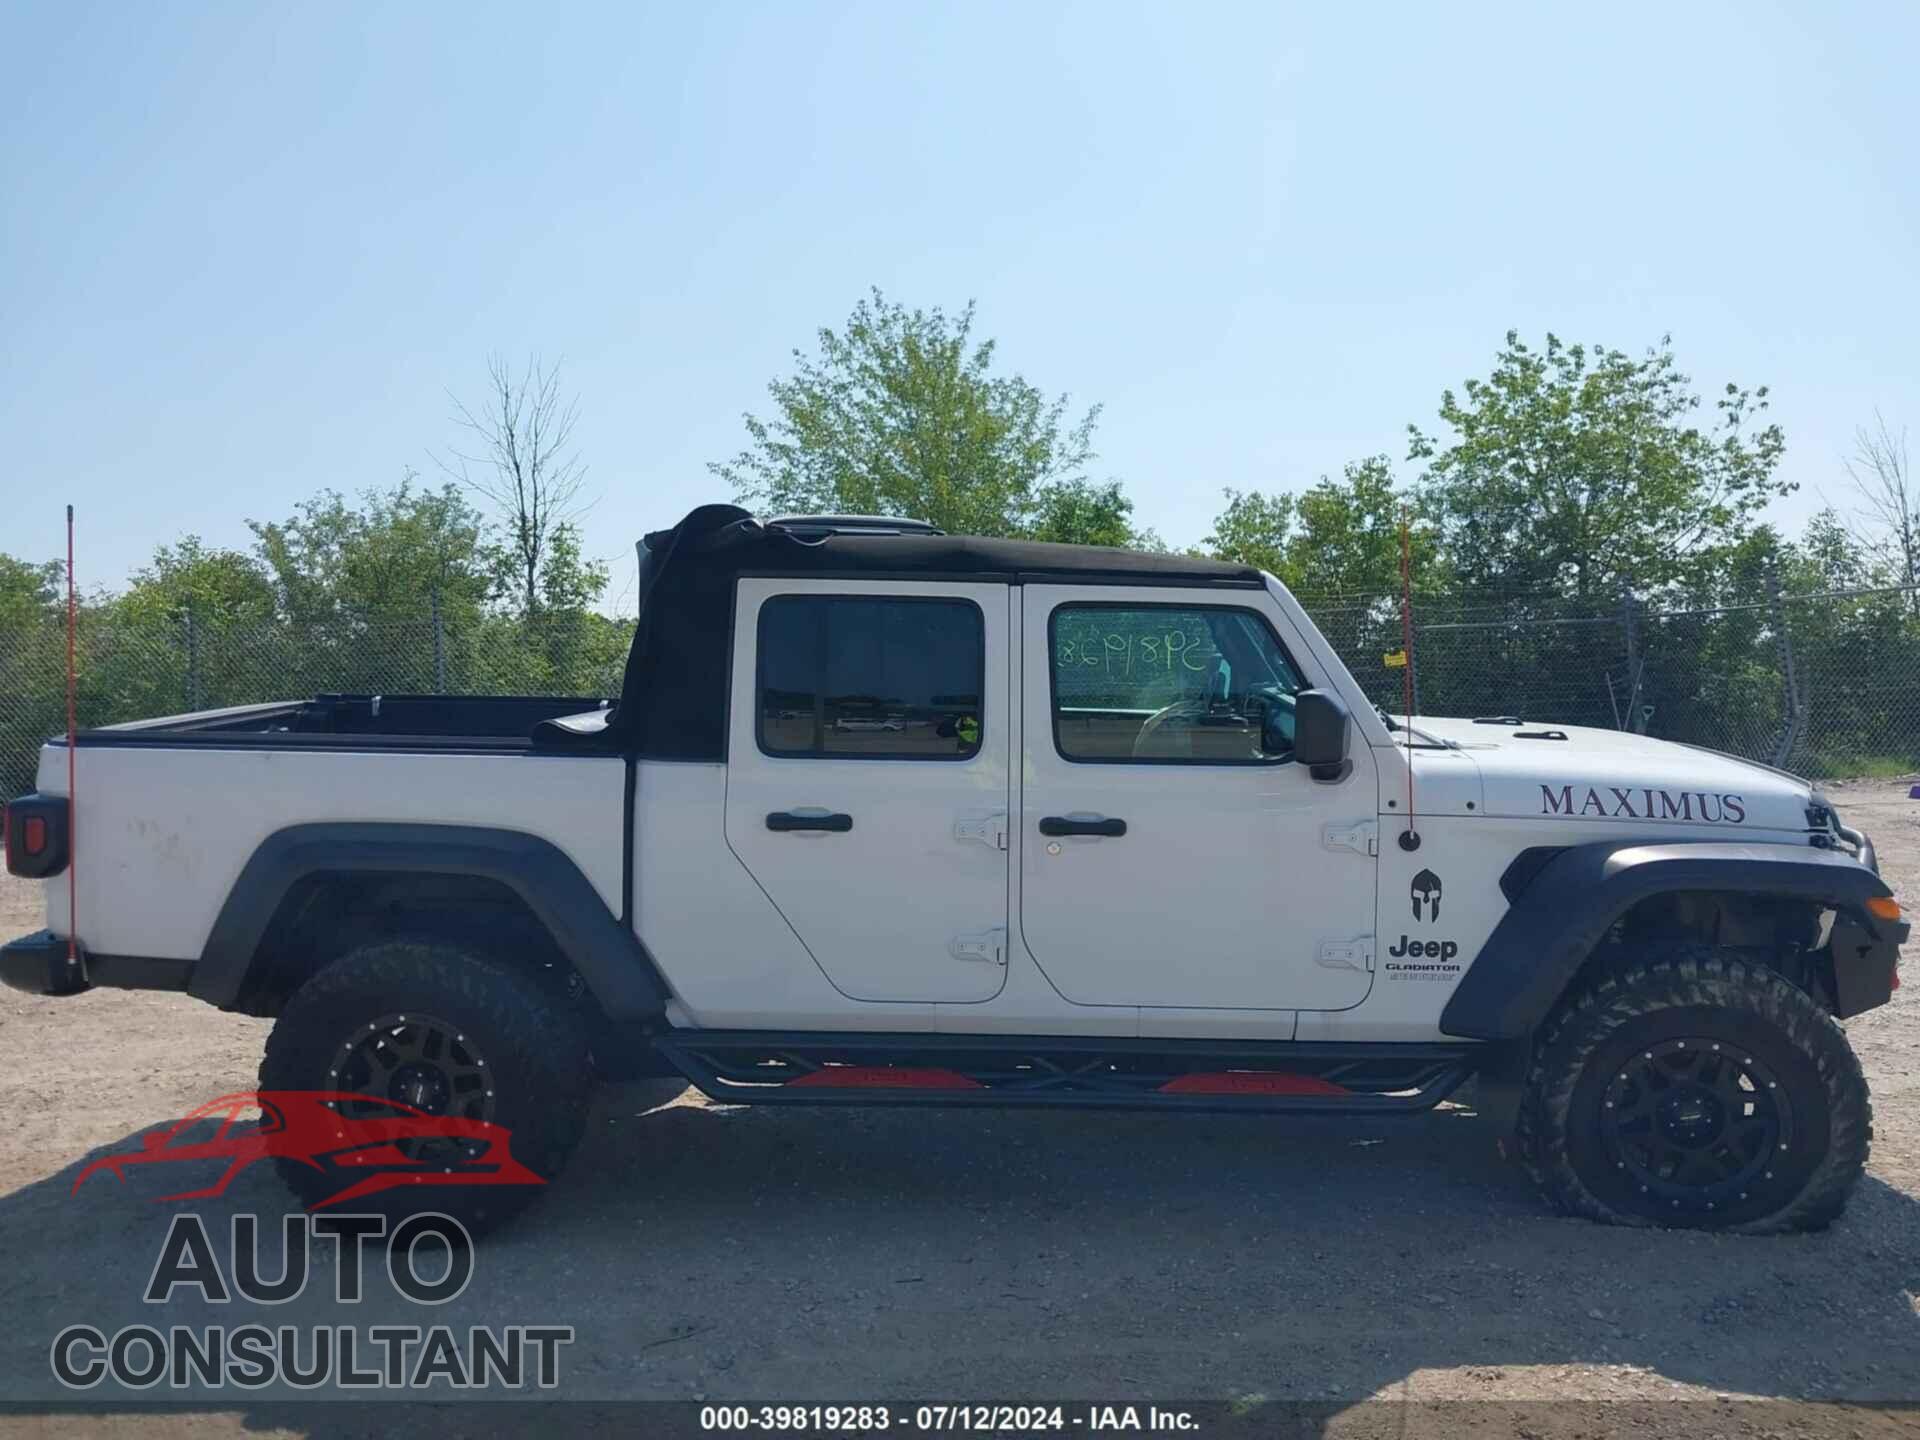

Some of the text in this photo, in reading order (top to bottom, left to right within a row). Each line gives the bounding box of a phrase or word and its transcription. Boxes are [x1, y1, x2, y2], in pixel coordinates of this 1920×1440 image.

[1541, 784, 1746, 823] MAXIMUS
[1388, 935, 1458, 962] Jeep
[1385, 962, 1461, 972] GLADIATOR
